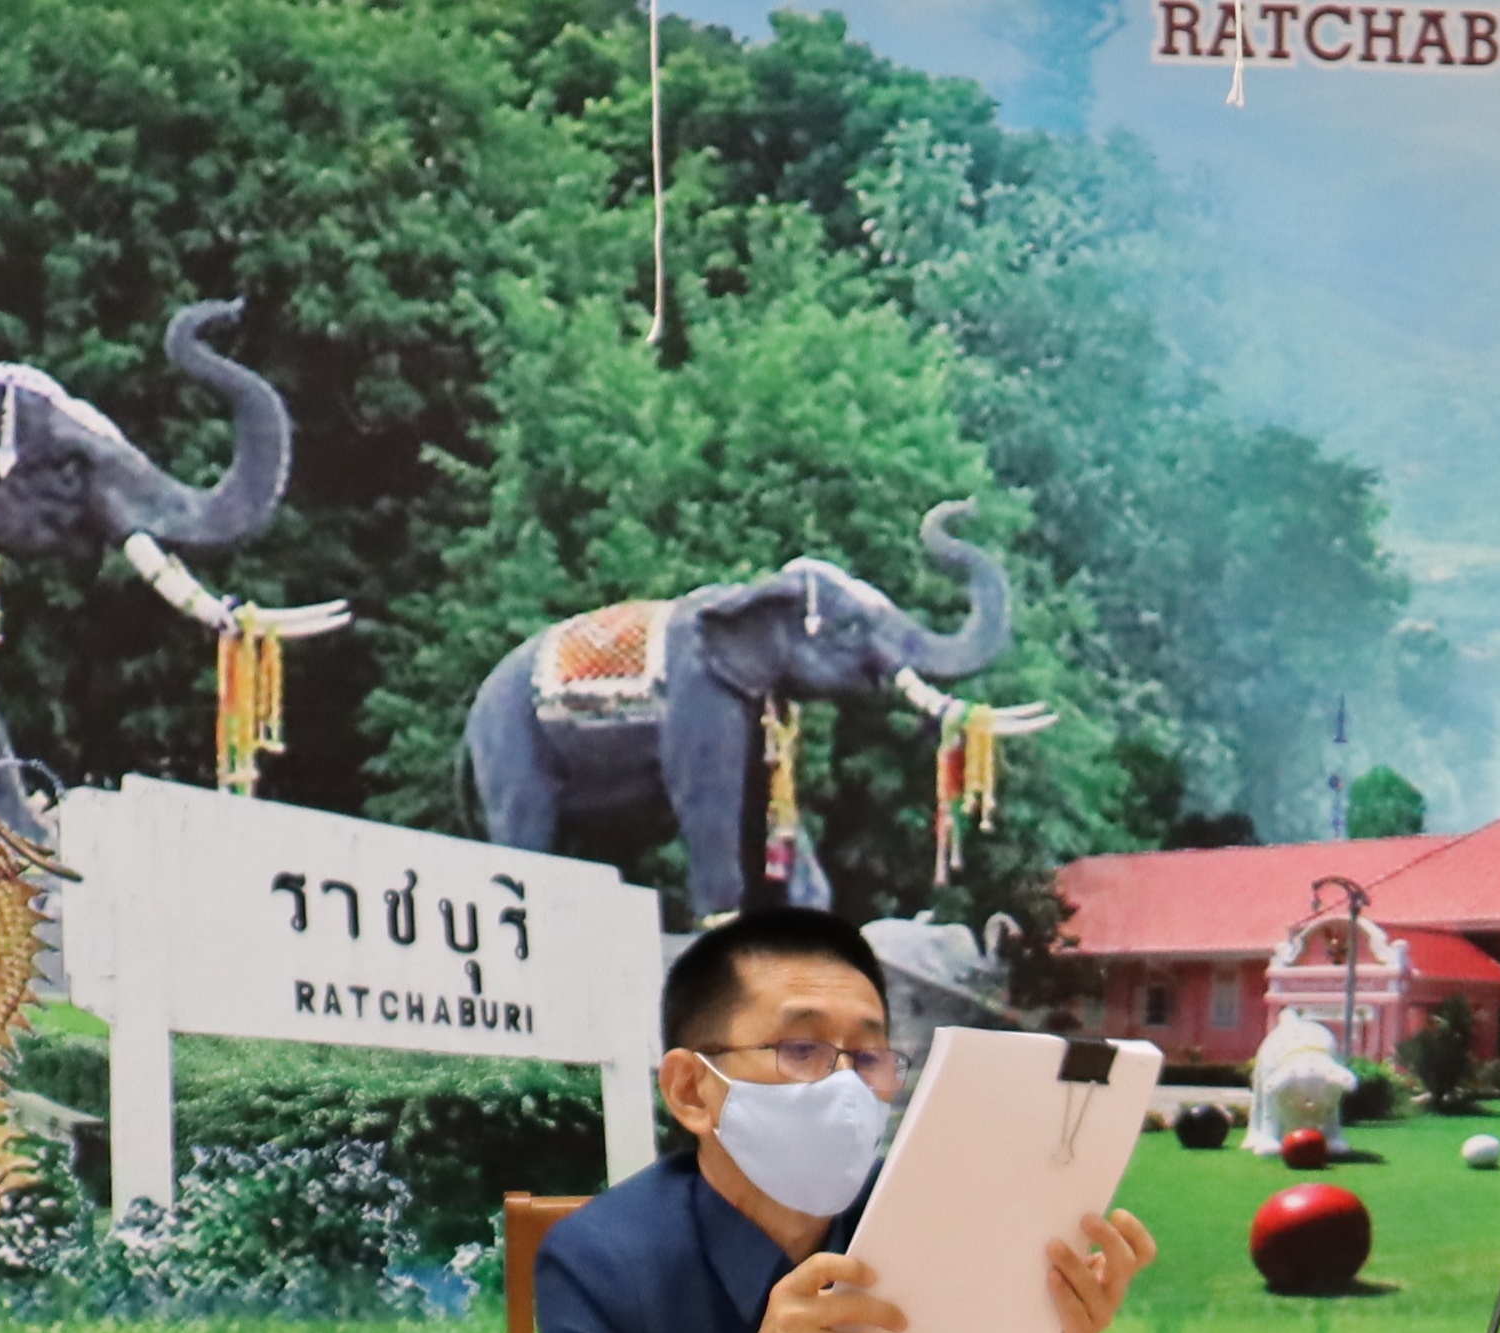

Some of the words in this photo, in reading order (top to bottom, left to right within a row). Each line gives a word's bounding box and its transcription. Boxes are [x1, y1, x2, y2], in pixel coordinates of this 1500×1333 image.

[271, 867, 530, 995] ราชบุรี
[294, 979, 534, 1034] RATCHABURI
